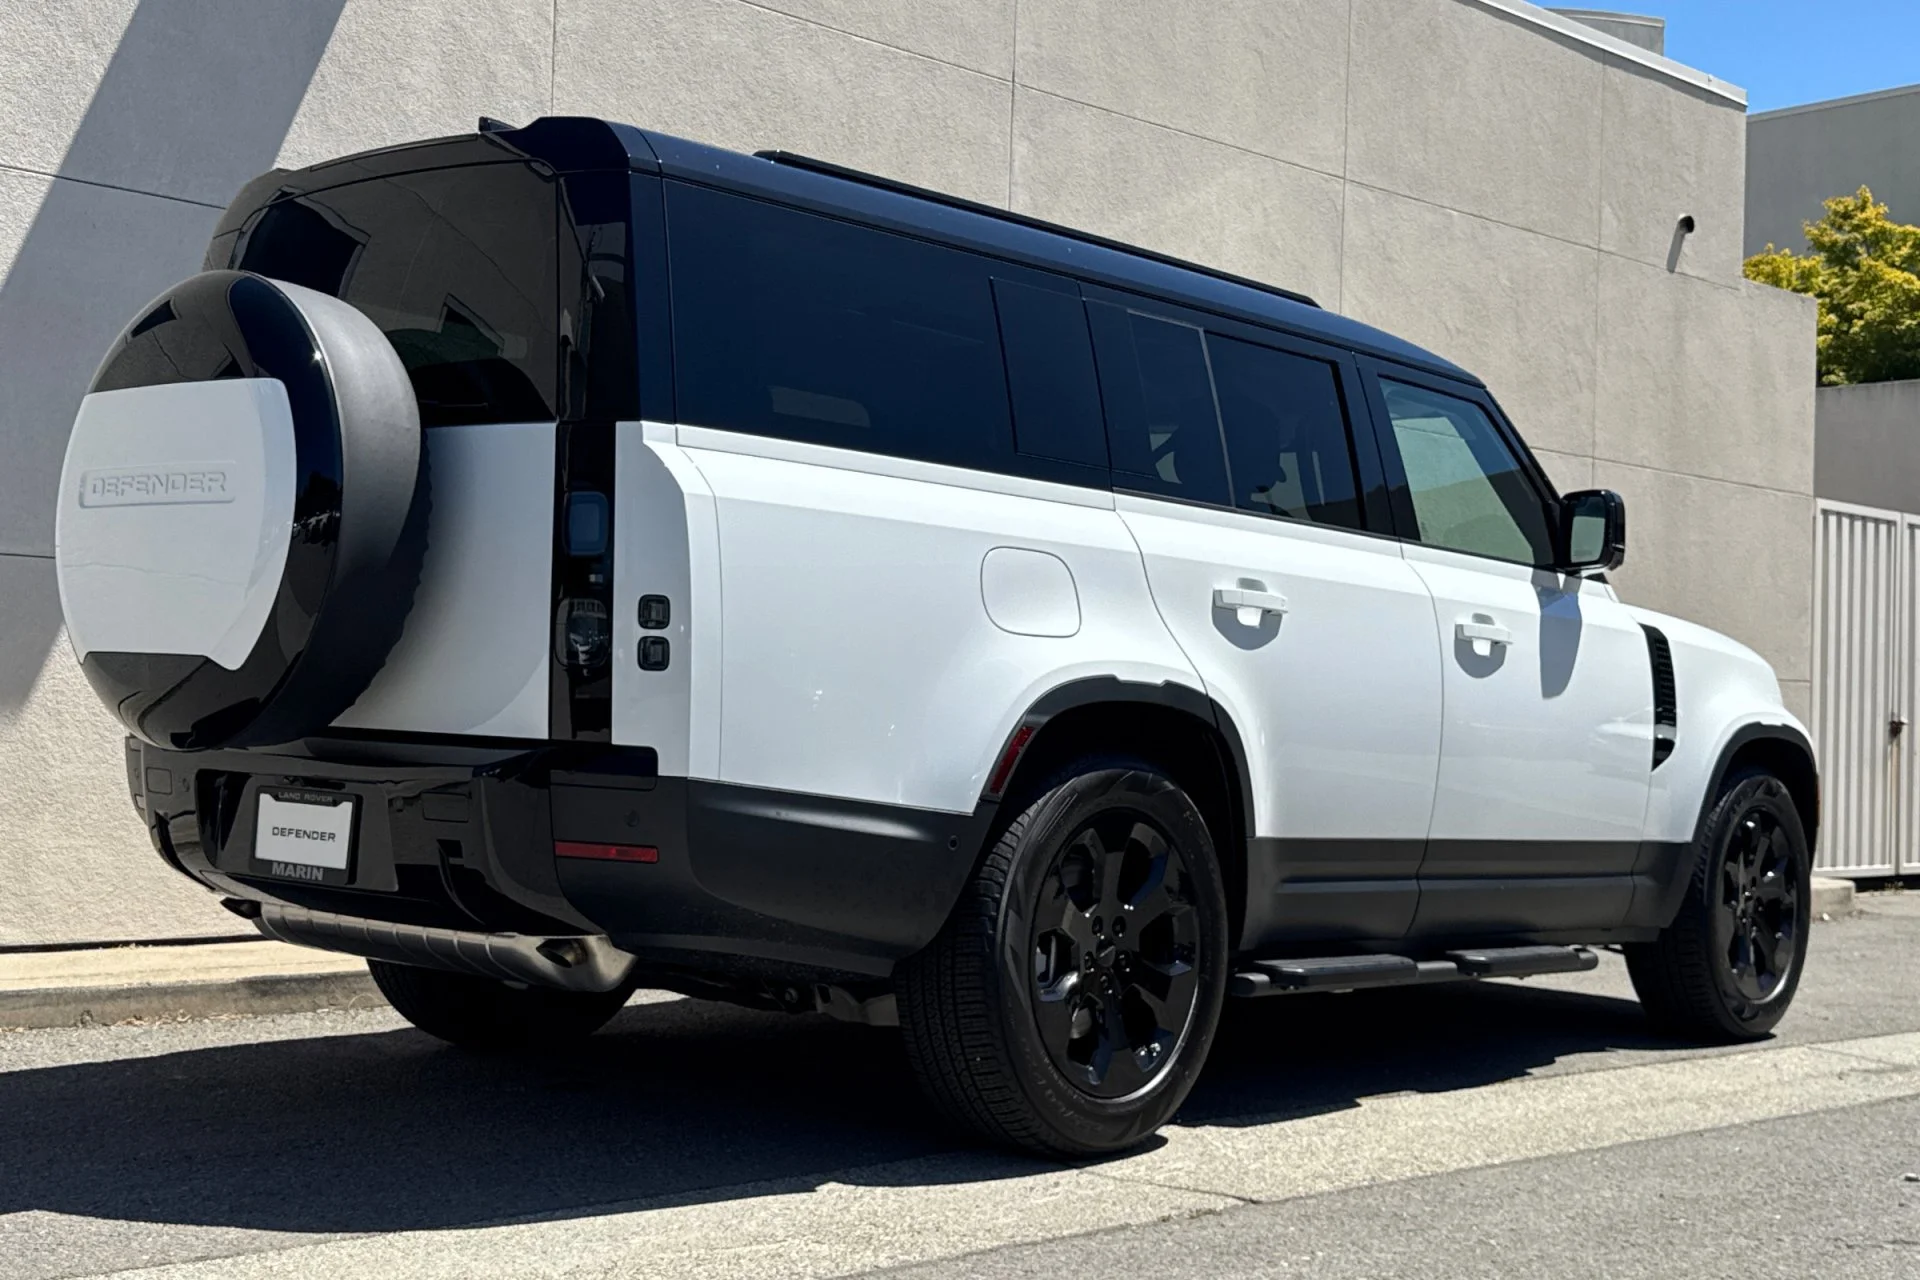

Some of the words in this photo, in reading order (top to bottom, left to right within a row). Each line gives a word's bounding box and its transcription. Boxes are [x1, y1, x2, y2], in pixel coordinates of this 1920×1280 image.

[92, 471, 226, 497] DEFENDER
[278, 791, 300, 800] LAND
[304, 793, 333, 803] ROVER
[272, 826, 336, 842] DEFENDER
[271, 861, 324, 881] MARIN
